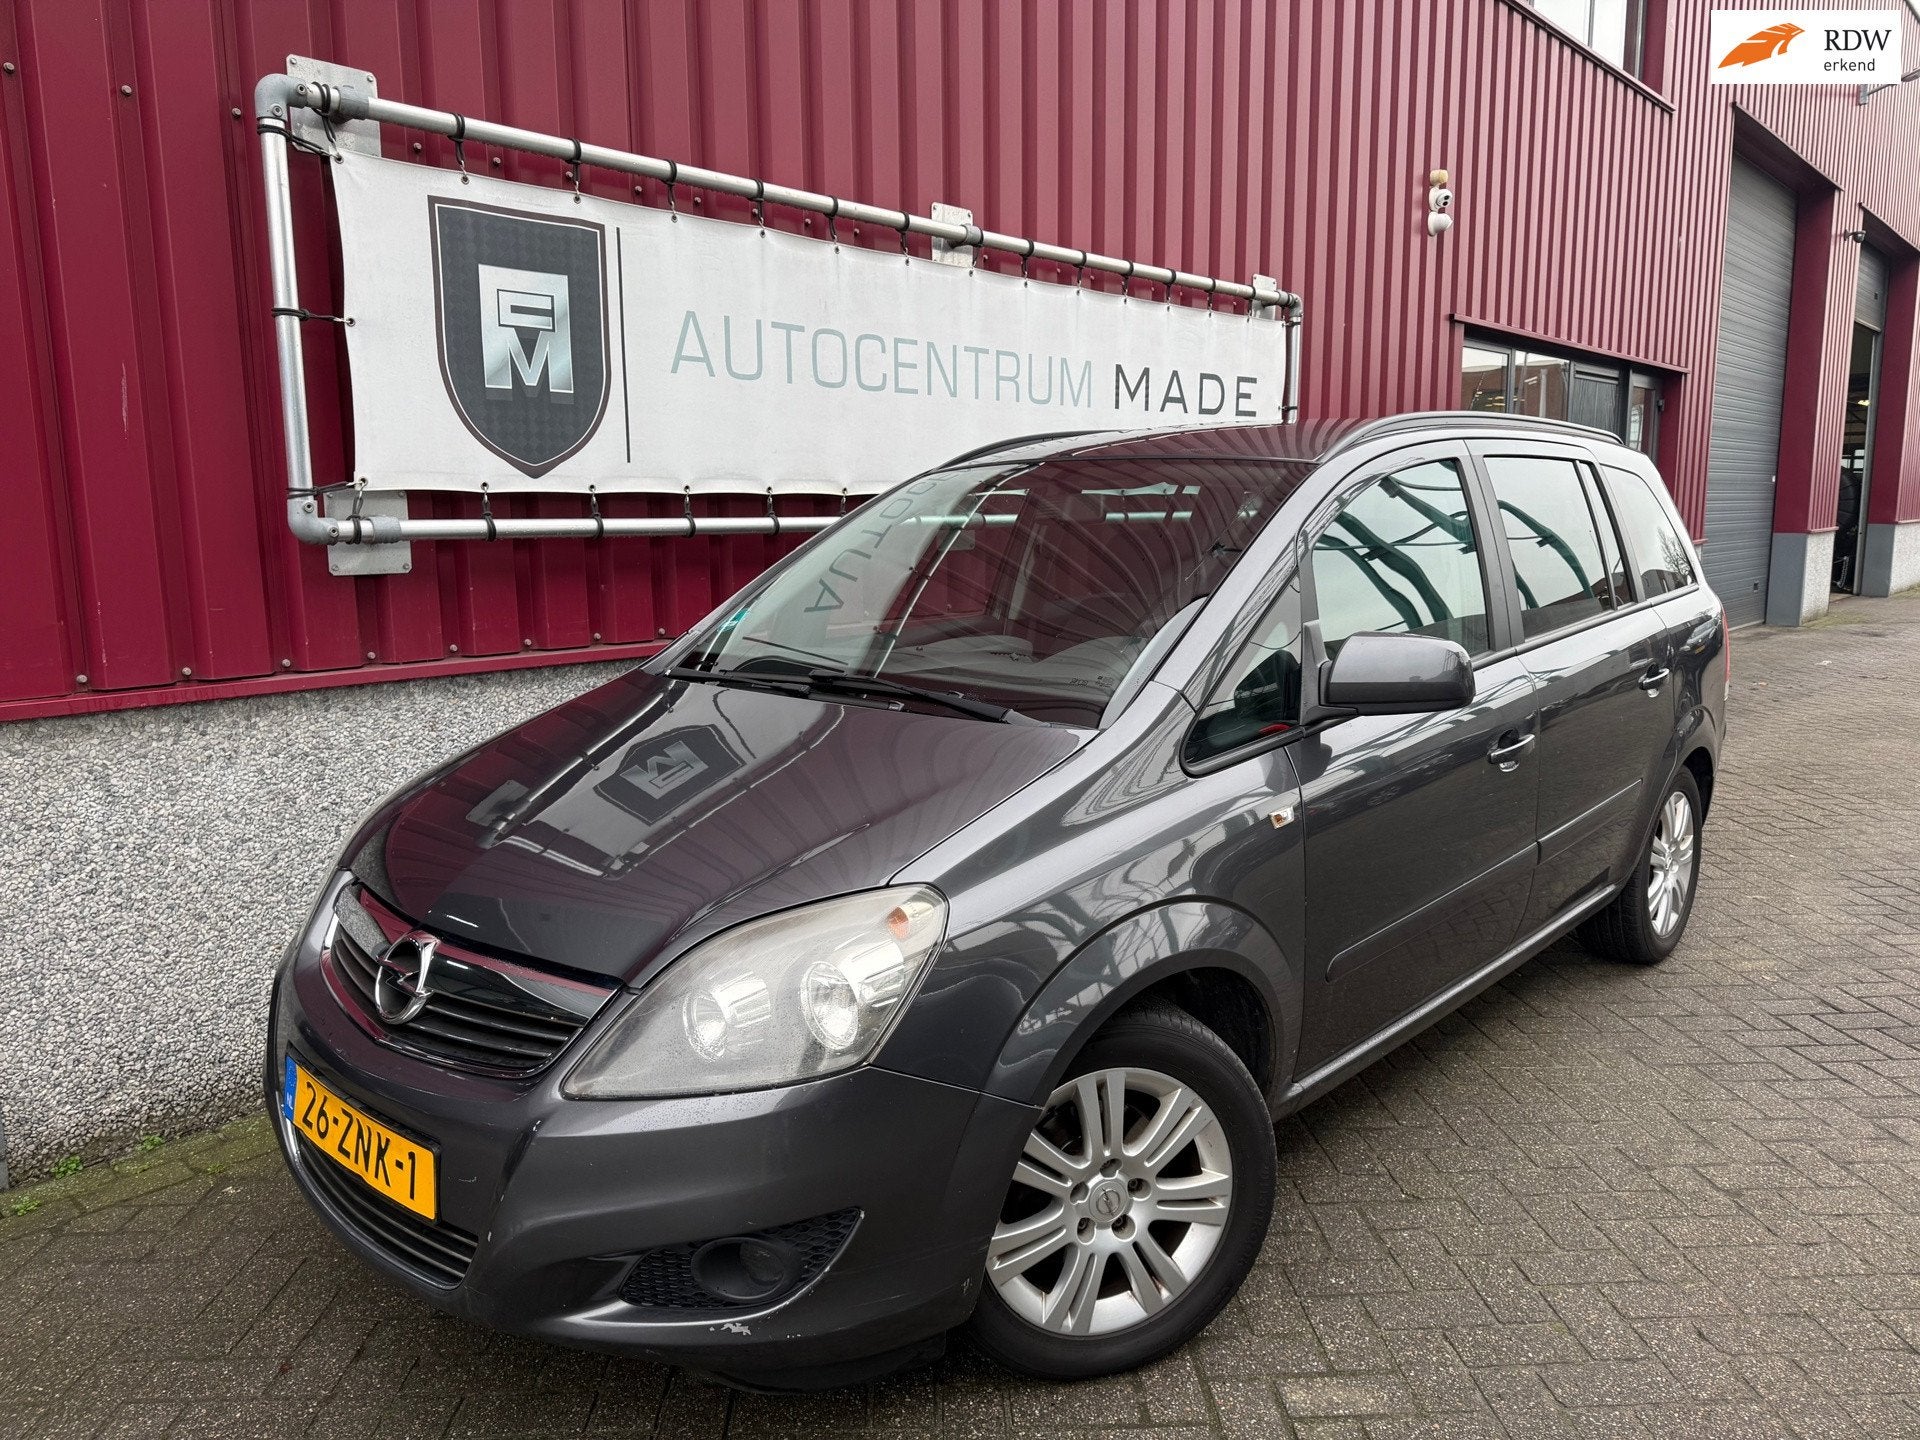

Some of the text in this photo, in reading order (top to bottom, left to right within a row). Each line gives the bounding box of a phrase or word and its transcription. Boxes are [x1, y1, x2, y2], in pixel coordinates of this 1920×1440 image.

[670, 310, 1258, 417] AUTOCENTRUM MADE
[302, 1081, 416, 1200] 26-ZNK-1
